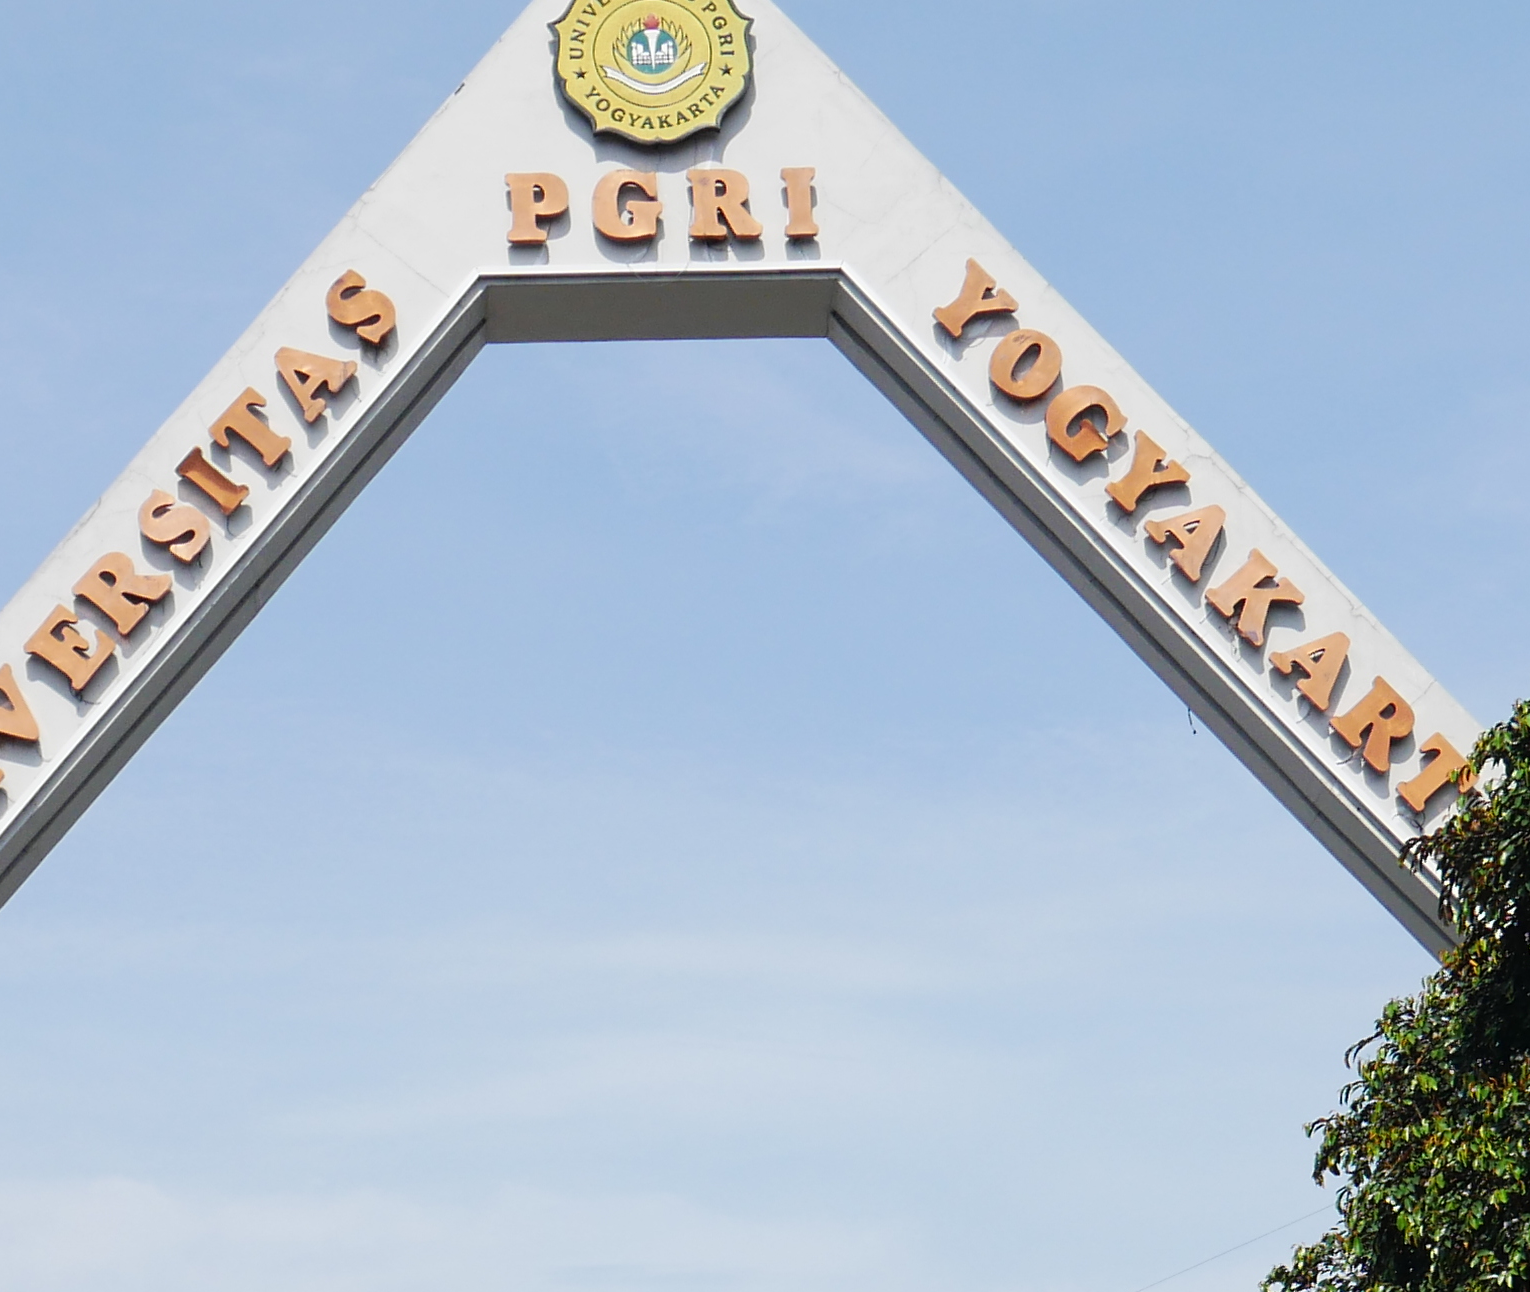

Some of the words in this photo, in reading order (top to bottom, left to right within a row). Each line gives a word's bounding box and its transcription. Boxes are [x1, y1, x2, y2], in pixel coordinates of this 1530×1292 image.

[701, 2, 735, 57] PGRI
[585, 85, 725, 129] YOGYAKARTA
[505, 167, 818, 244] PGRI
[933, 257, 1479, 812] YOGYAKART
